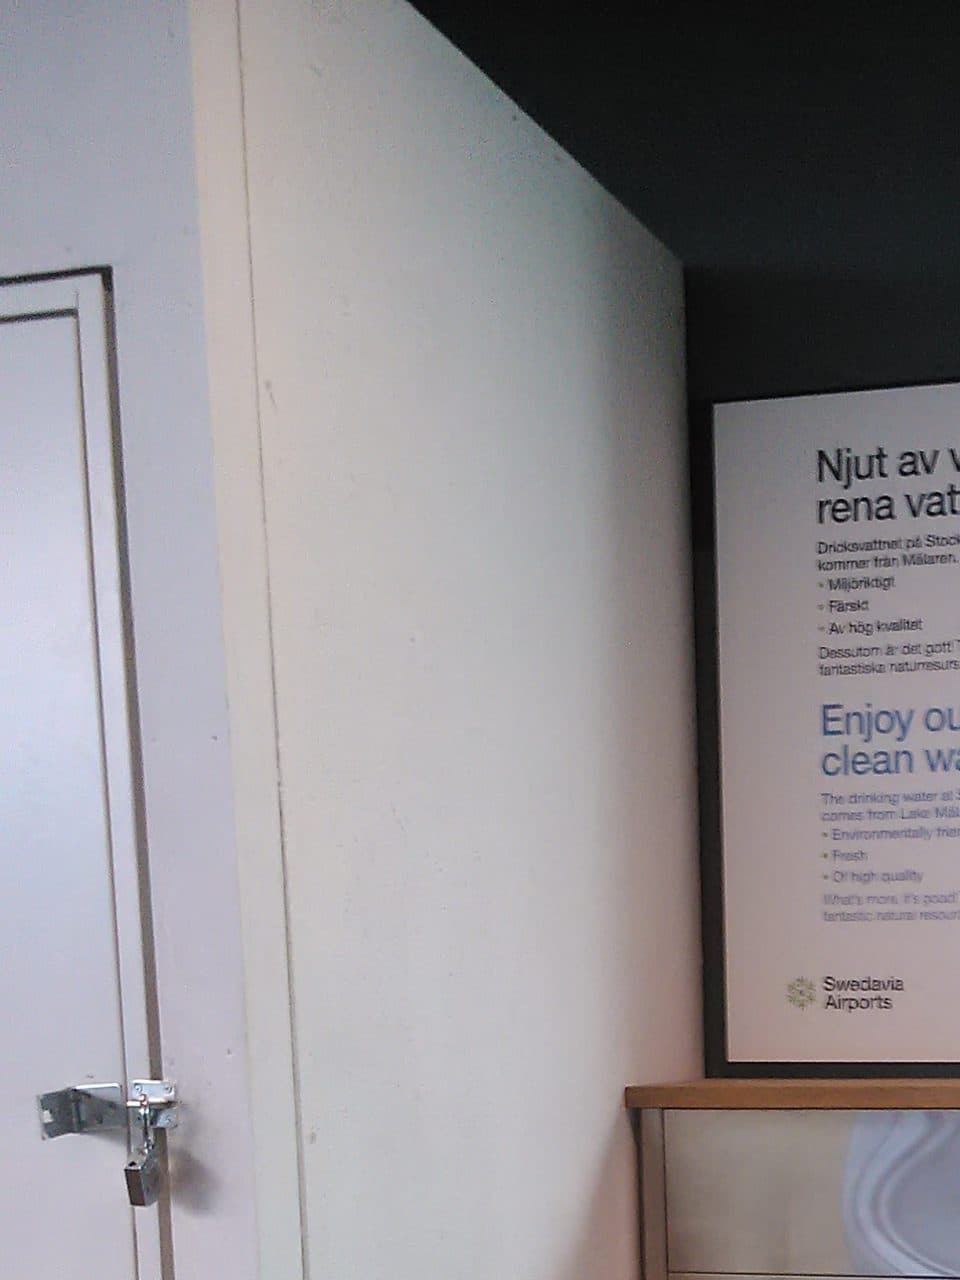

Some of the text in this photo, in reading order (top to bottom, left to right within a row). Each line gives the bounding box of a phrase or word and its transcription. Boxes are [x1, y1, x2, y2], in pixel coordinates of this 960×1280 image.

[817, 447, 888, 489] Njut
[898, 448, 939, 476] av
[817, 494, 894, 523] rena
[817, 556, 870, 571] kommer
[873, 555, 900, 569] från
[828, 575, 897, 592] Miljöriktigt
[829, 618, 924, 636] Av hög kvalitet
[819, 645, 882, 660] Dessutom
[901, 642, 921, 656] det
[822, 703, 914, 742] Enjoy
[822, 745, 913, 776] clean
[821, 792, 845, 804] The
[849, 790, 900, 805] drinking
[903, 790, 938, 801] water
[822, 809, 862, 821] comes
[867, 808, 897, 819] from
[901, 807, 931, 819] Lake
[832, 827, 933, 840] Environmentally
[832, 849, 868, 861] Fresh
[832, 869, 924, 884] Of high quality
[823, 975, 904, 992] Swedavia
[825, 994, 893, 1013] Airports
